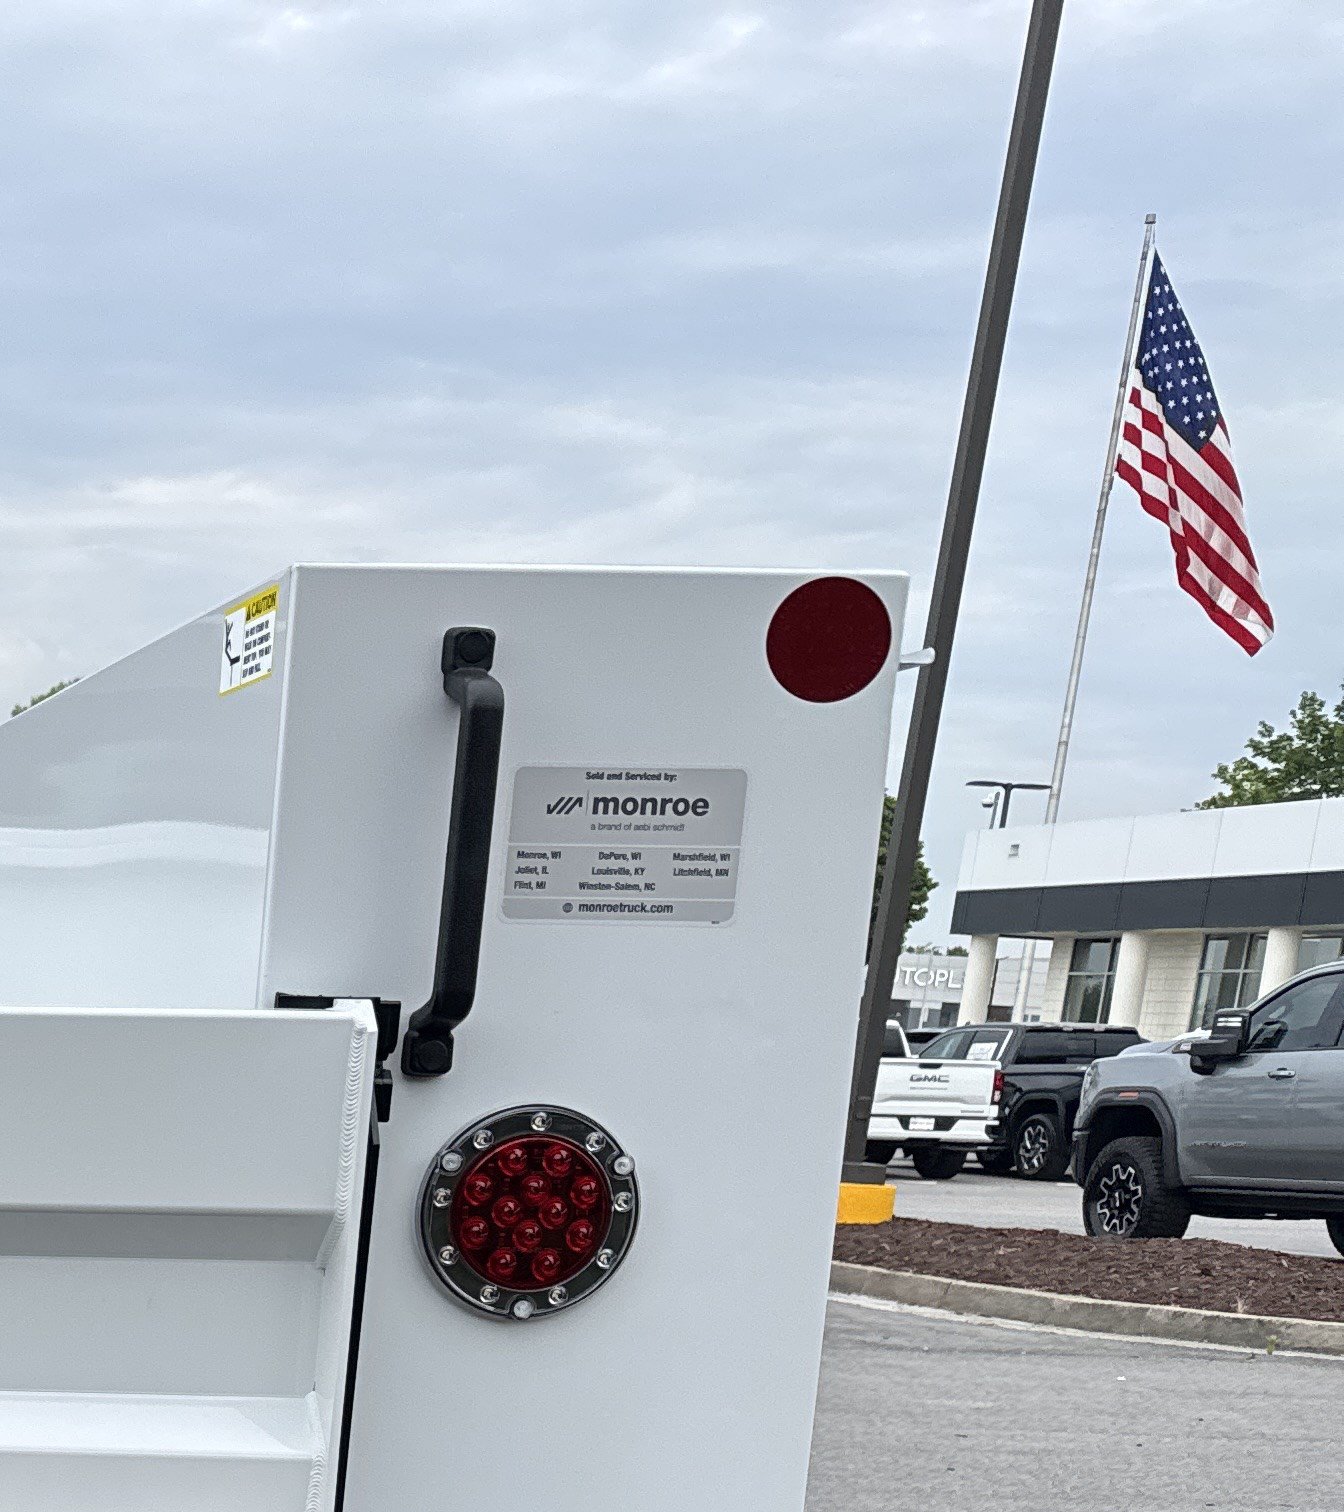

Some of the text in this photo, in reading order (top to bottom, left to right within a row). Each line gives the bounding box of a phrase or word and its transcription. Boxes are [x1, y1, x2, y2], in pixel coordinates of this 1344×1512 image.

[585, 771, 678, 782] Sold and Serviced by:
[591, 796, 710, 817] monroe
[598, 823, 622, 831] brand
[623, 822, 632, 831] of
[516, 850, 561, 860] Monroe, WI
[631, 852, 642, 860] WI
[720, 853, 731, 861] WI
[591, 866, 646, 877] Louisville, KY
[643, 882, 656, 891] NC
[578, 901, 674, 913] monroetruck.com
[909, 1073, 950, 1083] GMC
